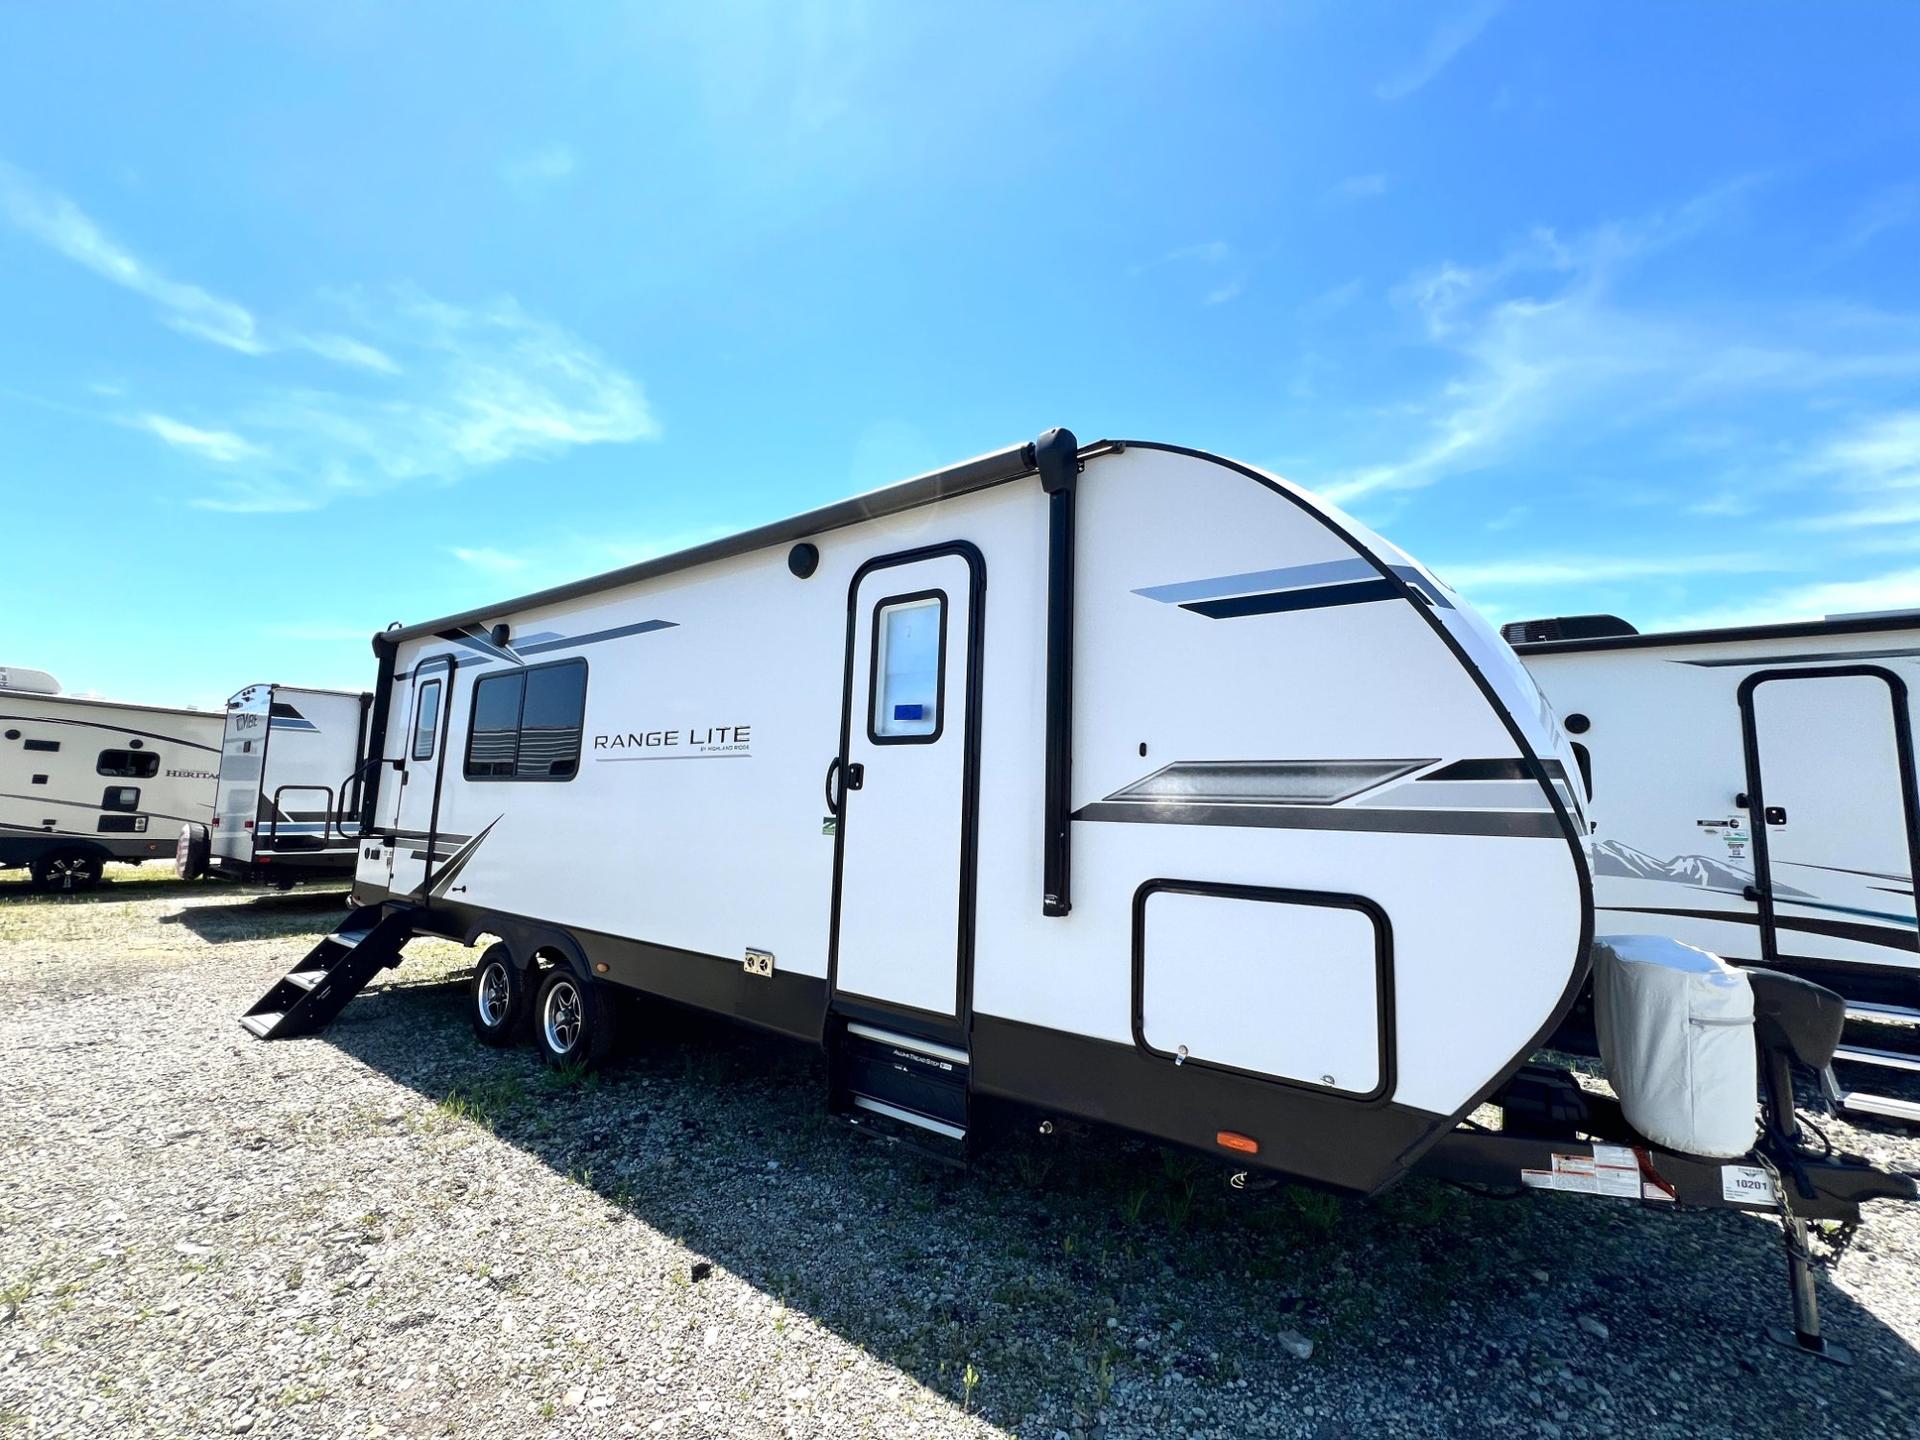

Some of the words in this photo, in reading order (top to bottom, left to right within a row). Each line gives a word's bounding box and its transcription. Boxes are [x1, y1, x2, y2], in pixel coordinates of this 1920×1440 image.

[594, 730, 679, 749] RANGE
[690, 726, 751, 745] LITE
[166, 769, 219, 779] HERITA
[1736, 1179, 1767, 1190] 10201
